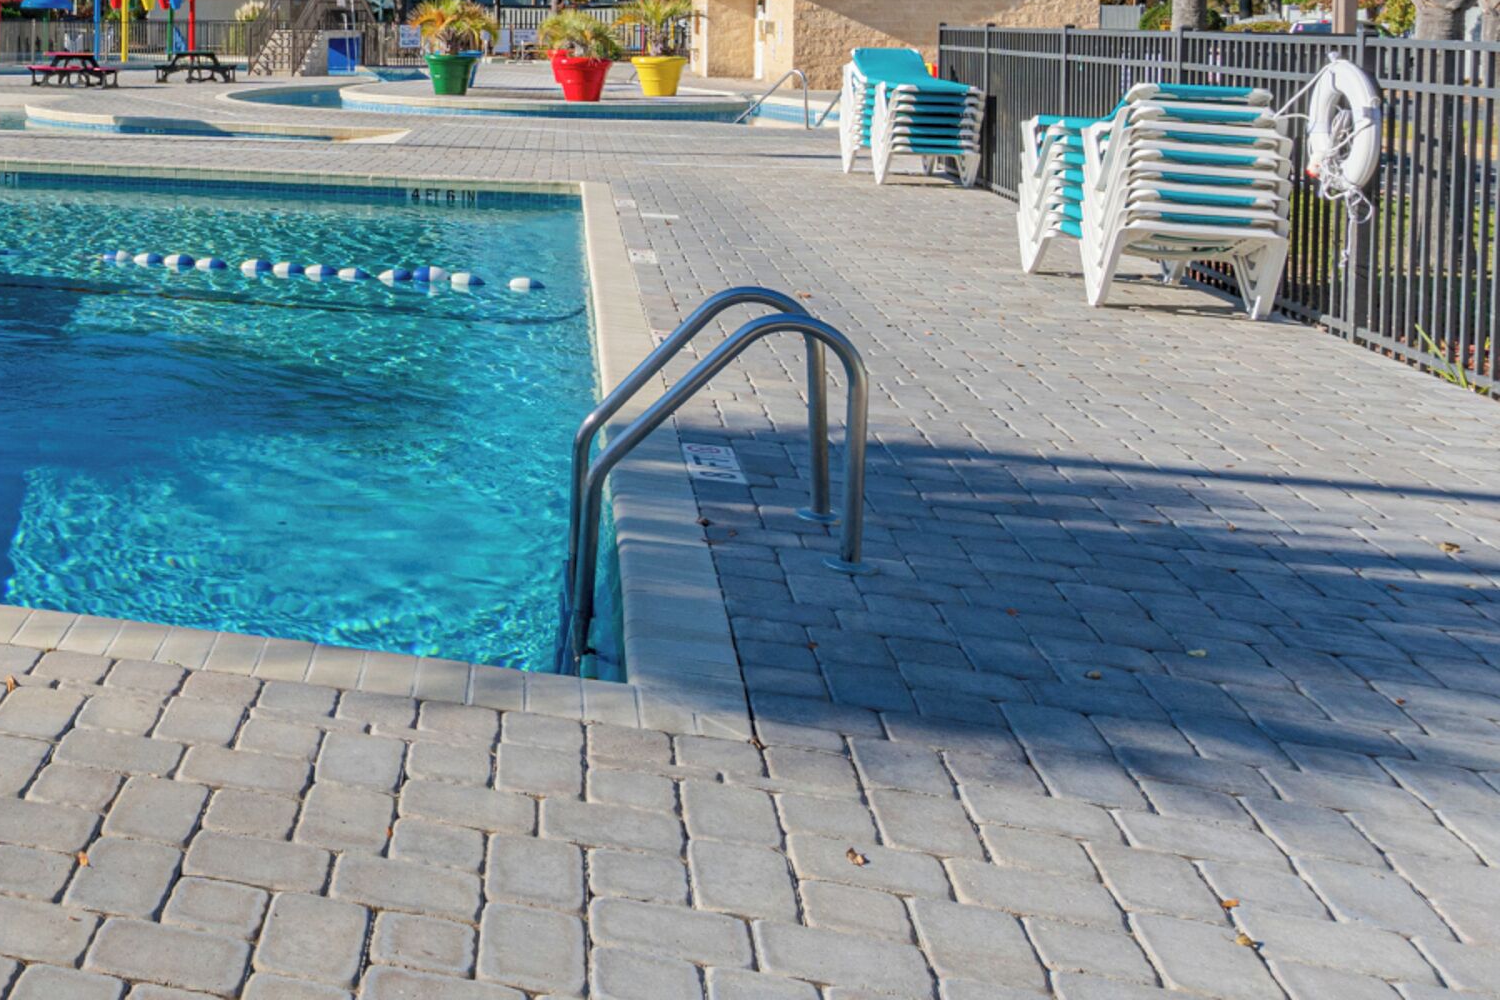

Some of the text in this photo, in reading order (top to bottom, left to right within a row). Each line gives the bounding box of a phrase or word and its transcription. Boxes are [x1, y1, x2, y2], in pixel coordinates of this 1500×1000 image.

[4, 171, 16, 185] FT
[412, 188, 475, 207] 4 FT 6 IN
